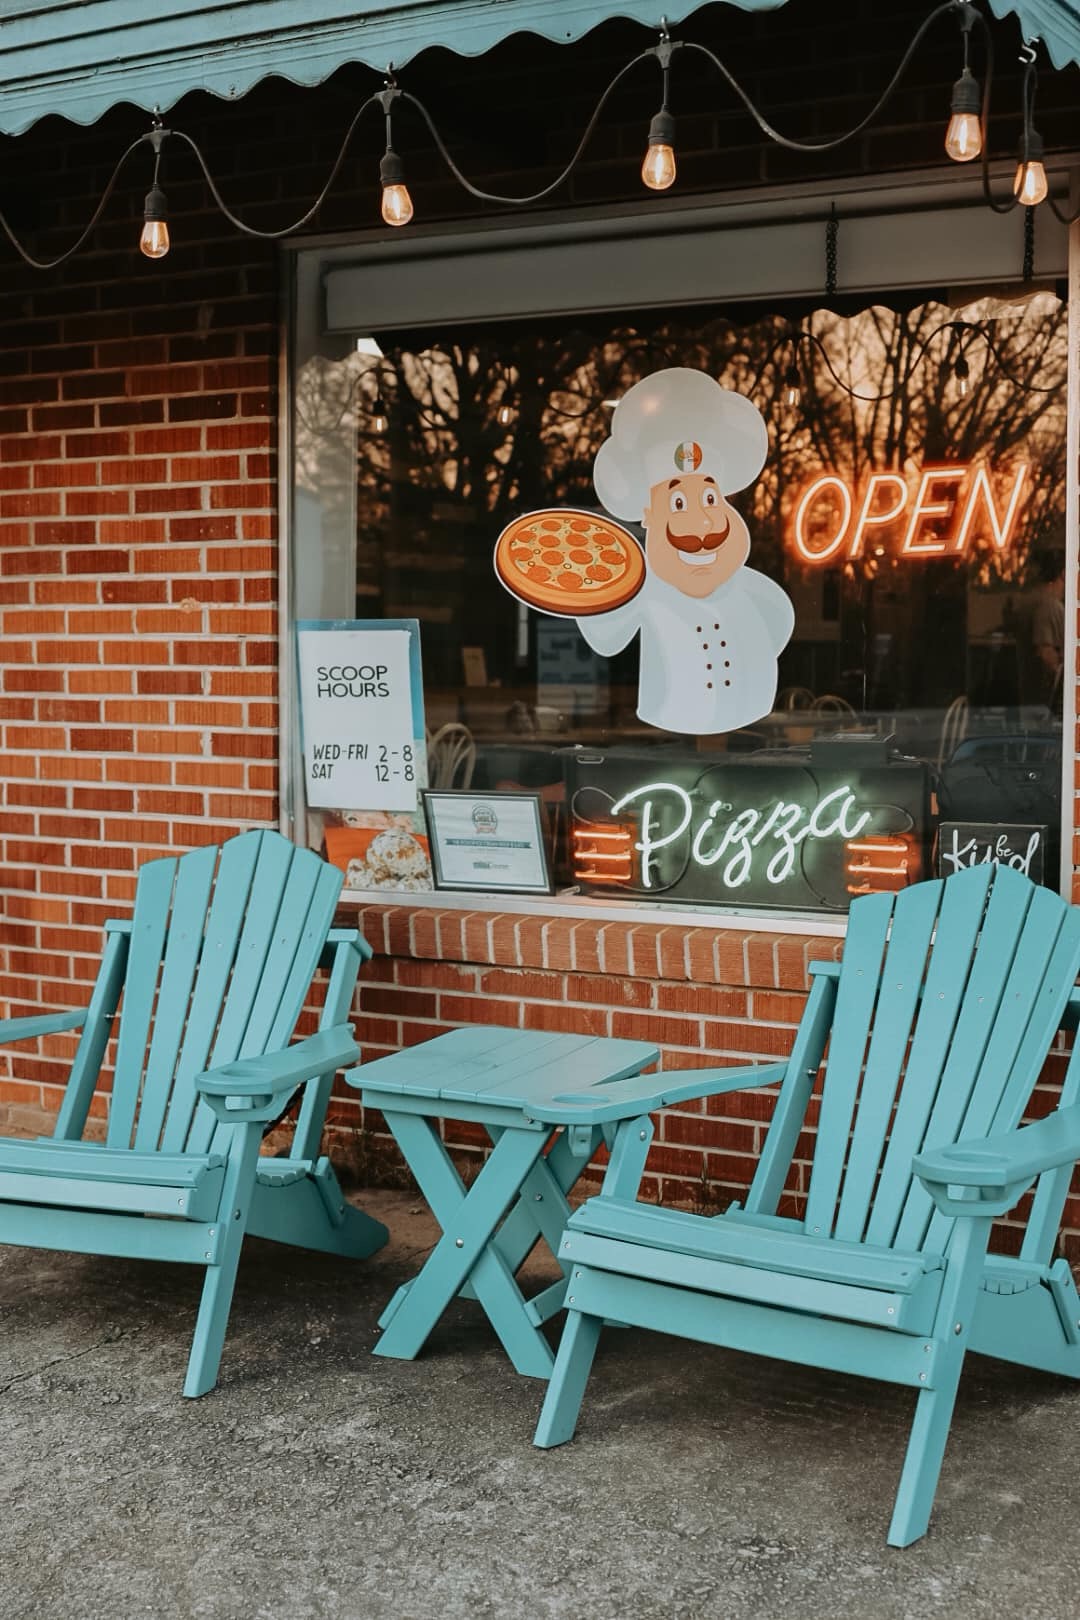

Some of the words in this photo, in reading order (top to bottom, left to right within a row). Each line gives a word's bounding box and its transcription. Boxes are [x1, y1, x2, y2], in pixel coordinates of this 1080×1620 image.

[795, 463, 1027, 560] OPEN
[317, 665, 388, 681] SCOOP
[317, 682, 390, 698] HOURS
[313, 744, 368, 760] WED-FRI
[311, 763, 334, 779] SAT
[611, 782, 871, 888] Pizza
[996, 834, 1014, 857] be
